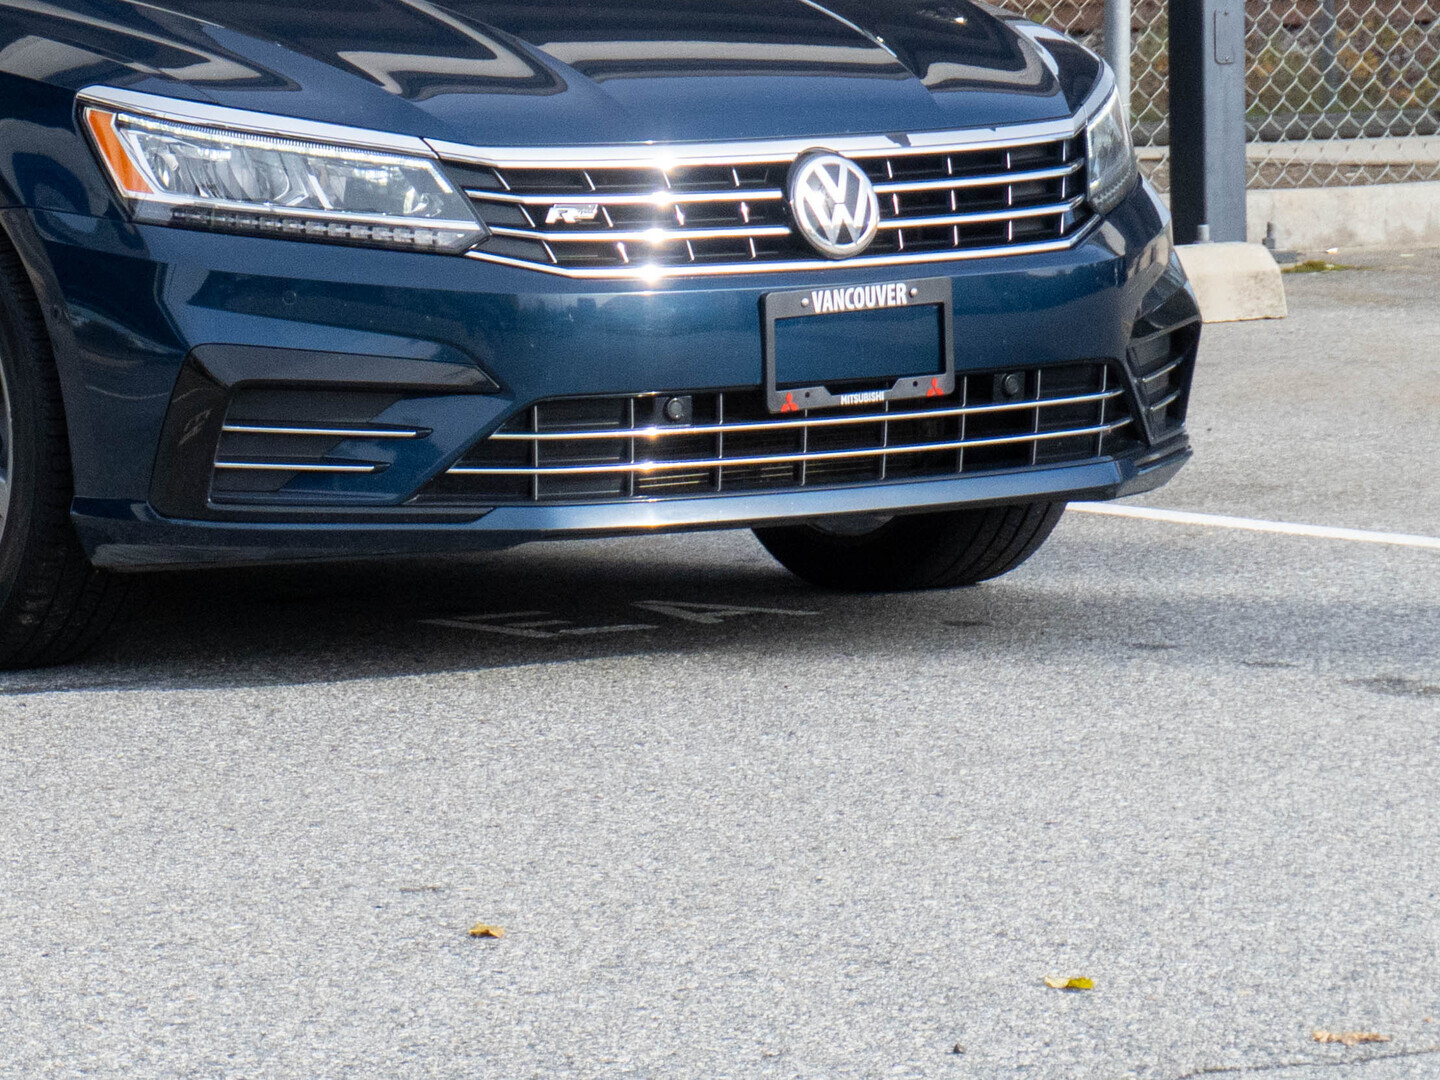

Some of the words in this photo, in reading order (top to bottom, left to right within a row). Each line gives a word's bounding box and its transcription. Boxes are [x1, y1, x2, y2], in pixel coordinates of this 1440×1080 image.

[793, 154, 879, 258] VW
[811, 283, 908, 314] VANCOUVER
[840, 390, 885, 406] MITSUBISHI
